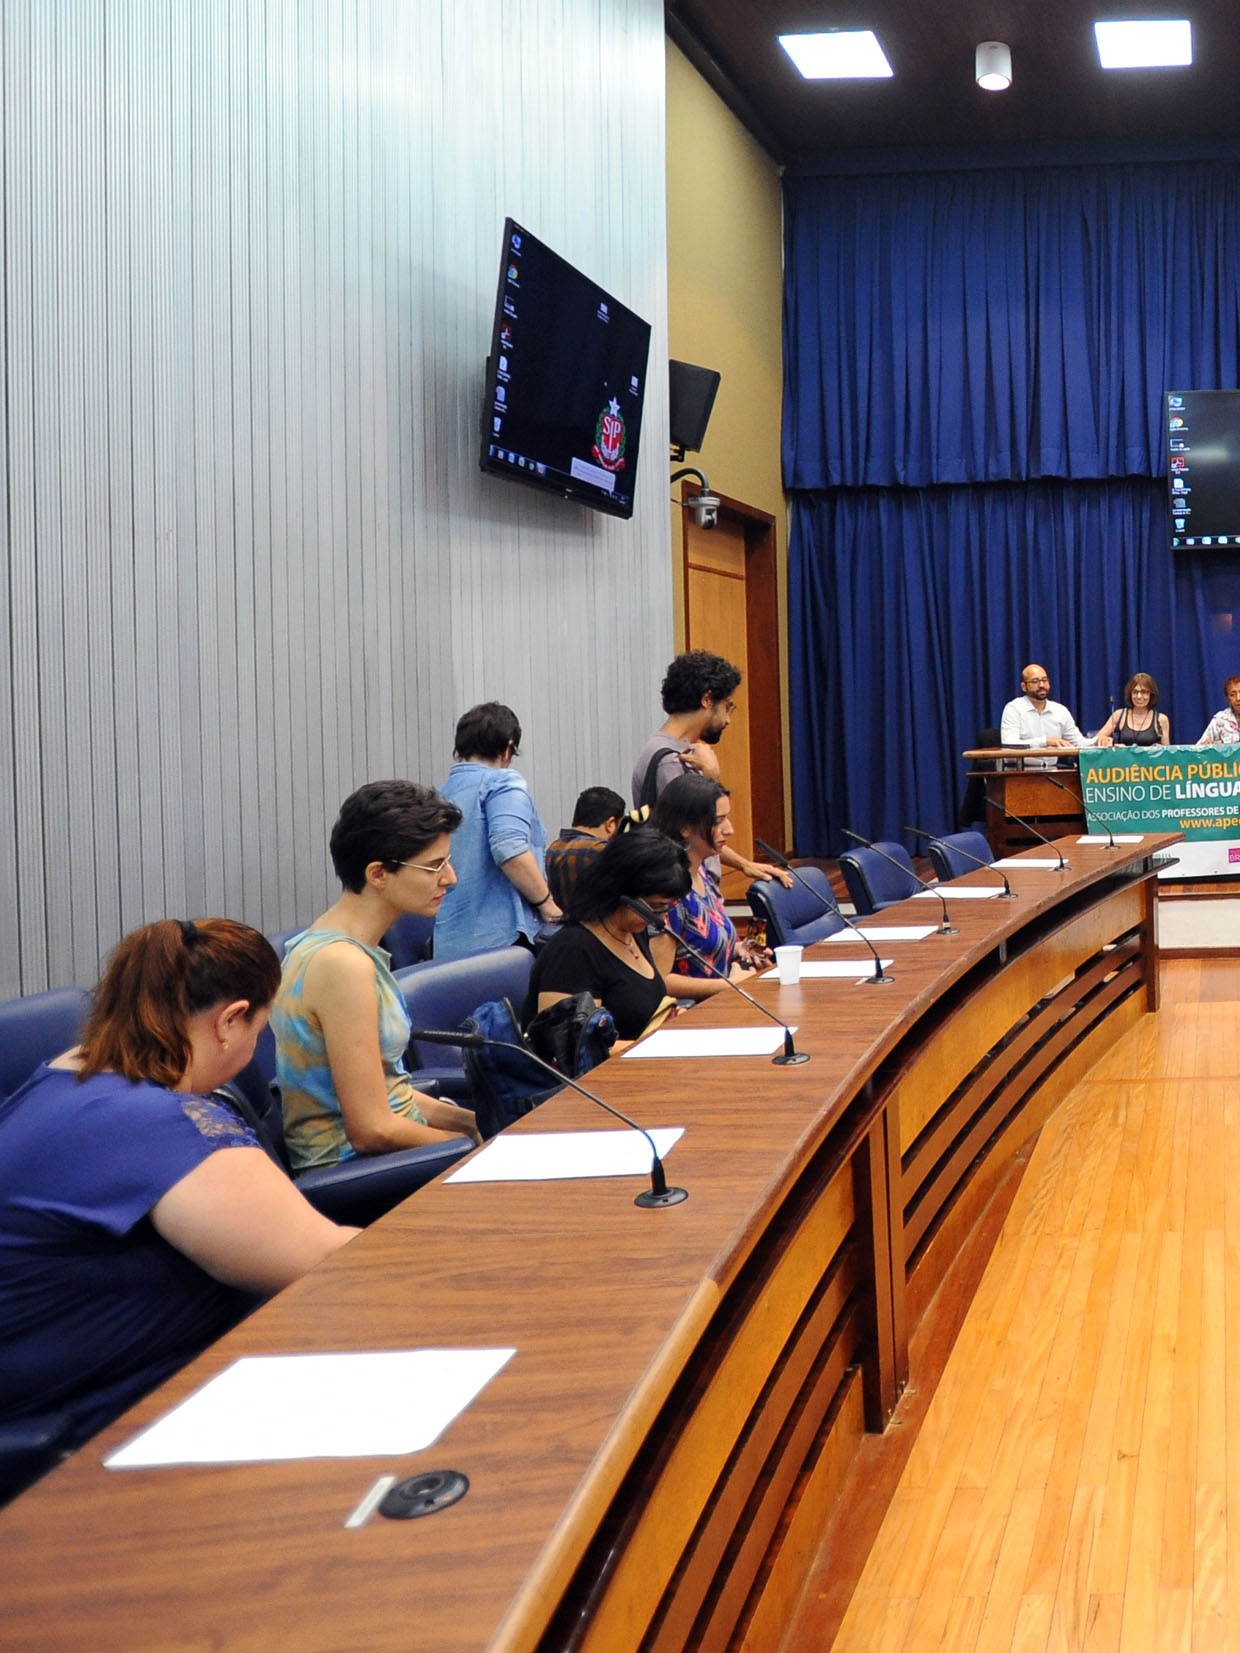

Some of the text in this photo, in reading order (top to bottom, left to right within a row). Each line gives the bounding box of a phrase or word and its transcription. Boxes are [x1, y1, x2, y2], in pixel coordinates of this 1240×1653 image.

[1086, 763, 1183, 784] AUDIÊNCIA
[1086, 785, 1146, 803] ENSINO
[1150, 784, 1172, 800] DE
[1087, 809, 1140, 822] ASSOCIAÇÃO
[1142, 809, 1161, 819] DOS
[1161, 806, 1225, 818] PROFESSORES
[1228, 805, 1239, 815] DE
